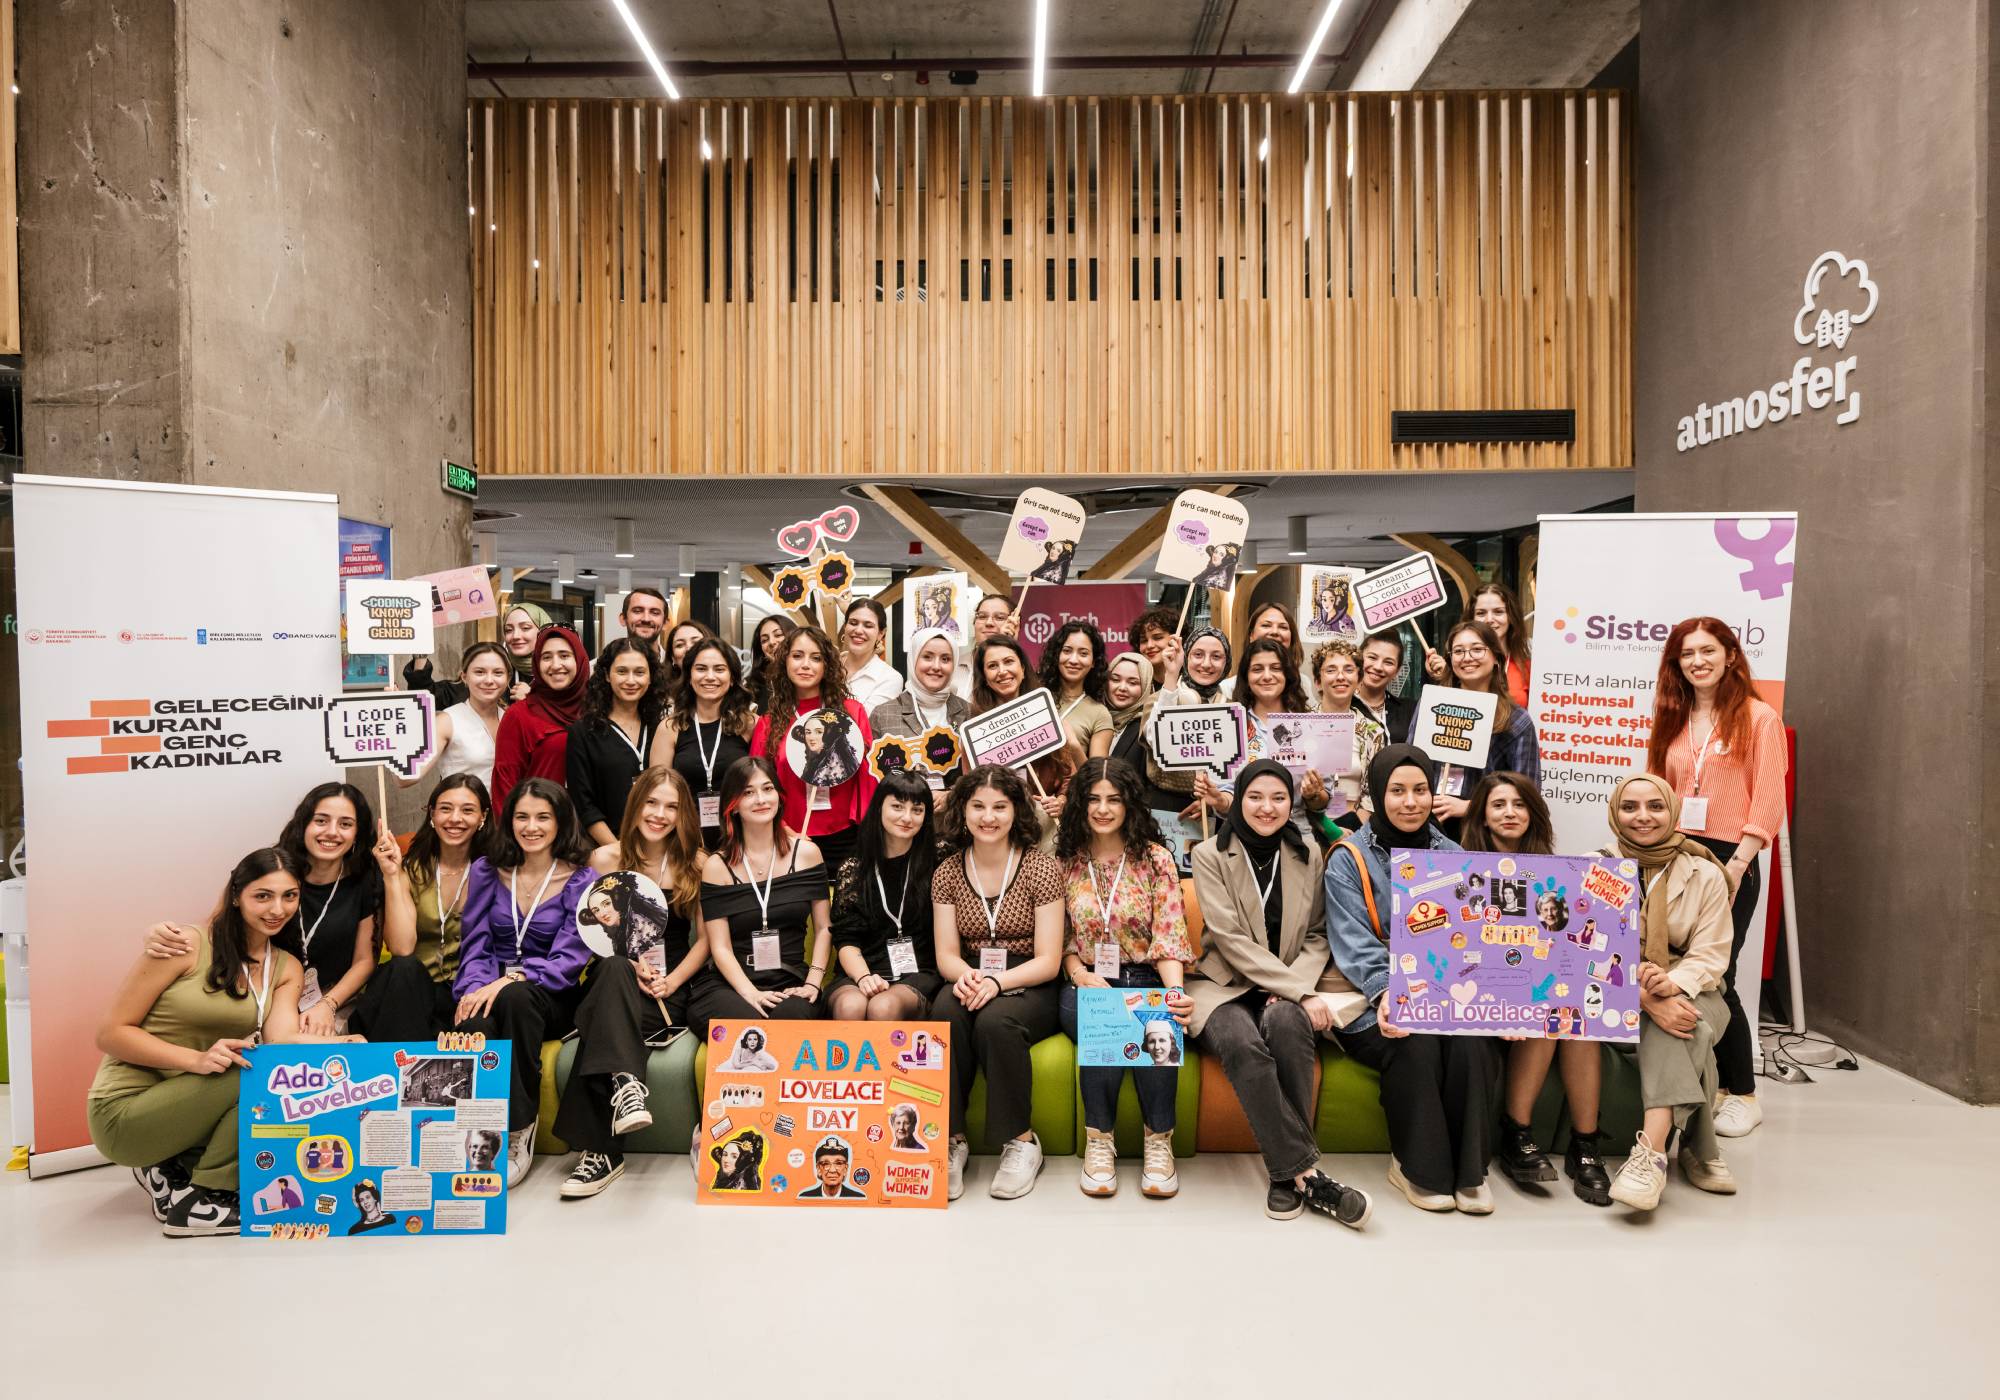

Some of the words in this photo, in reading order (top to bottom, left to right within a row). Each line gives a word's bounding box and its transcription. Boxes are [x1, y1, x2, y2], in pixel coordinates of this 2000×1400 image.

[1676, 356, 1857, 452] atmosfer
[1023, 497, 1037, 507] Girls
[1038, 502, 1049, 511] can
[1049, 506, 1061, 516] not
[1061, 509, 1081, 524] coding
[1180, 500, 1195, 509] Girls
[1196, 505, 1208, 513] can
[1209, 509, 1221, 517] not
[1221, 513, 1244, 526] coding
[1180, 525, 1198, 534] Except
[1375, 573, 1404, 588] dream
[1405, 567, 1412, 576] it
[1381, 587, 1401, 599] code
[1402, 582, 1410, 591] it
[1383, 602, 1399, 618] git
[1399, 598, 1410, 608] it
[1411, 587, 1432, 606] girl
[370, 607, 412, 618] KNOWS
[383, 617, 400, 628] NO
[369, 628, 414, 639] GENDER
[1613, 643, 1624, 651] ve
[1626, 643, 1665, 653] Teknolo
[1543, 672, 1590, 687] STEM
[1595, 675, 1655, 690] alanlar
[154, 694, 324, 714] GELECEĞİNİ
[1541, 691, 1635, 709] toplumsal
[343, 710, 348, 722] I
[358, 707, 406, 722] CODE
[988, 711, 1019, 731] dream
[1020, 706, 1029, 716] it
[1437, 715, 1474, 730] KNOWS
[1539, 709, 1612, 728] cinsiyet
[1617, 715, 1653, 732] eşit
[112, 716, 222, 735] KURAN
[344, 723, 386, 738] LIKE
[396, 722, 406, 735] A
[994, 727, 1017, 743] code
[1018, 723, 1027, 732] it
[1170, 721, 1174, 732] I
[1181, 718, 1221, 731] CODE
[1445, 726, 1461, 737] NO
[163, 733, 248, 751] GENÇ
[355, 737, 397, 752] GIRL
[996, 746, 1015, 763] git
[1014, 740, 1027, 753] it
[1027, 728, 1050, 750] girl
[1171, 732, 1206, 745] LIKE
[1213, 731, 1223, 743] A
[1433, 734, 1471, 750] GENDER
[1539, 728, 1566, 743] kız
[1570, 733, 1650, 749] çocuklar
[130, 749, 282, 770] KADINLAR
[1180, 745, 1215, 758] GIRL
[1538, 747, 1632, 767] kadınların
[1539, 767, 1624, 785] güçlenme
[1591, 865, 1631, 895] WOMEN
[1584, 878, 1624, 908] WOMEN
[1397, 999, 1442, 1021] Ada
[1450, 999, 1546, 1021] Lovelace
[791, 1039, 882, 1072] ADA
[270, 1064, 325, 1090] Ada
[283, 1078, 394, 1120] Lovelace
[781, 1080, 883, 1100] LOVELACE
[812, 1108, 856, 1129] DAY
[887, 1165, 930, 1180] WOMEN
[885, 1181, 929, 1196] WOMEN
